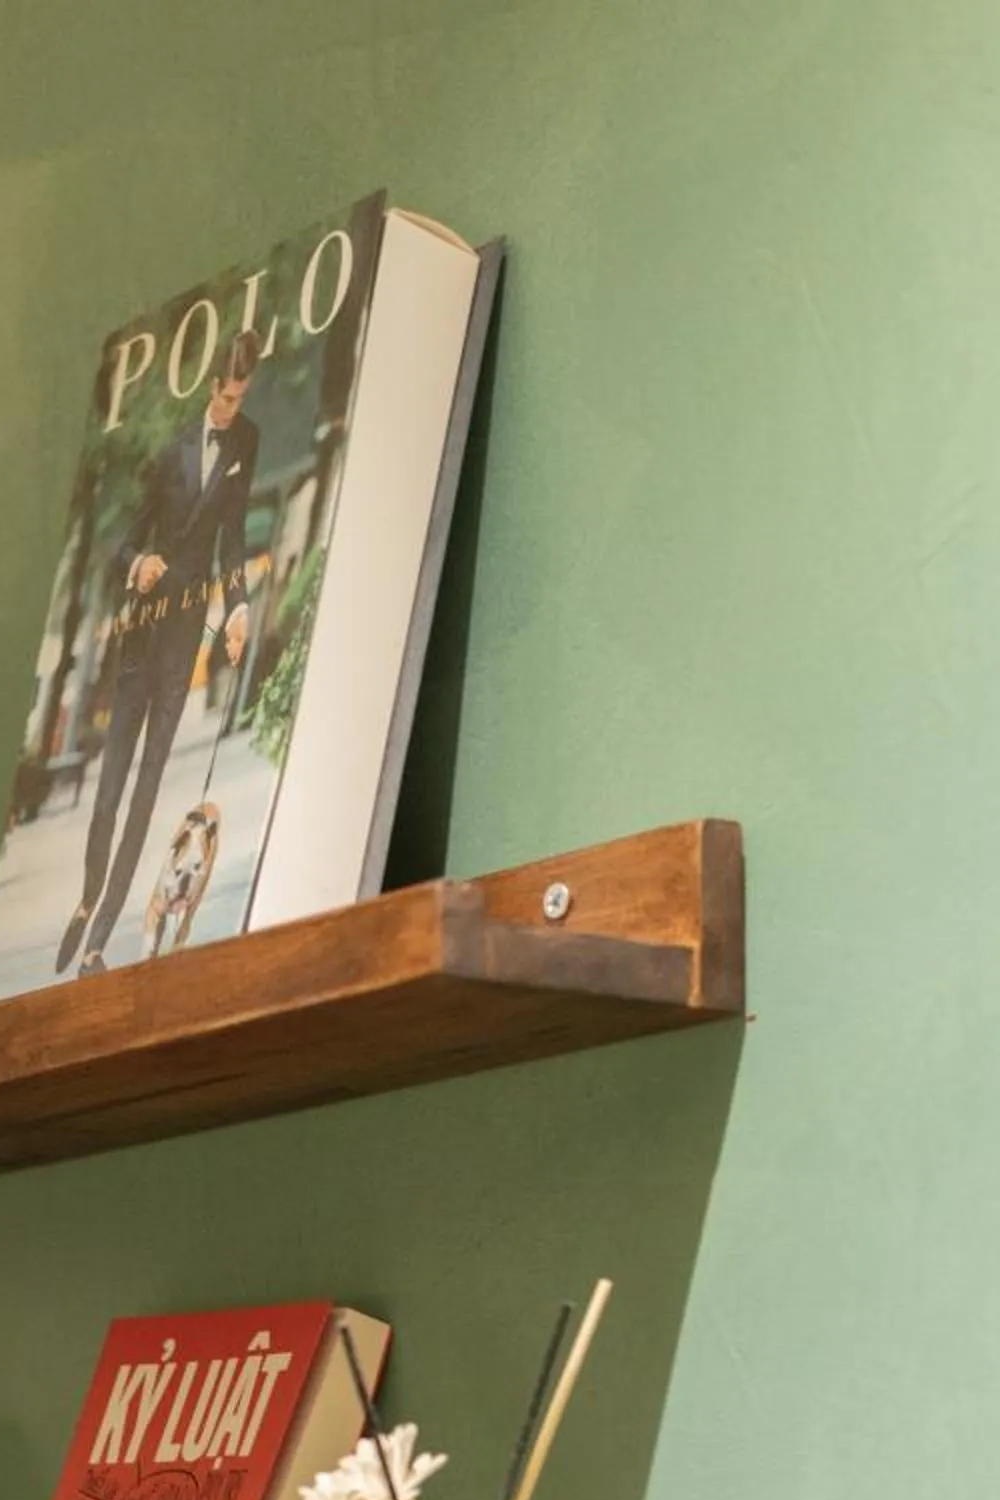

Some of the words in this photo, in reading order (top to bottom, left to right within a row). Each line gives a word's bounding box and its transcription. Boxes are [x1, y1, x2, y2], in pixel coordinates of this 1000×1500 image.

[103, 229, 354, 434] POLO
[89, 1337, 178, 1465] KỶ
[153, 1330, 293, 1470] LUẬT
